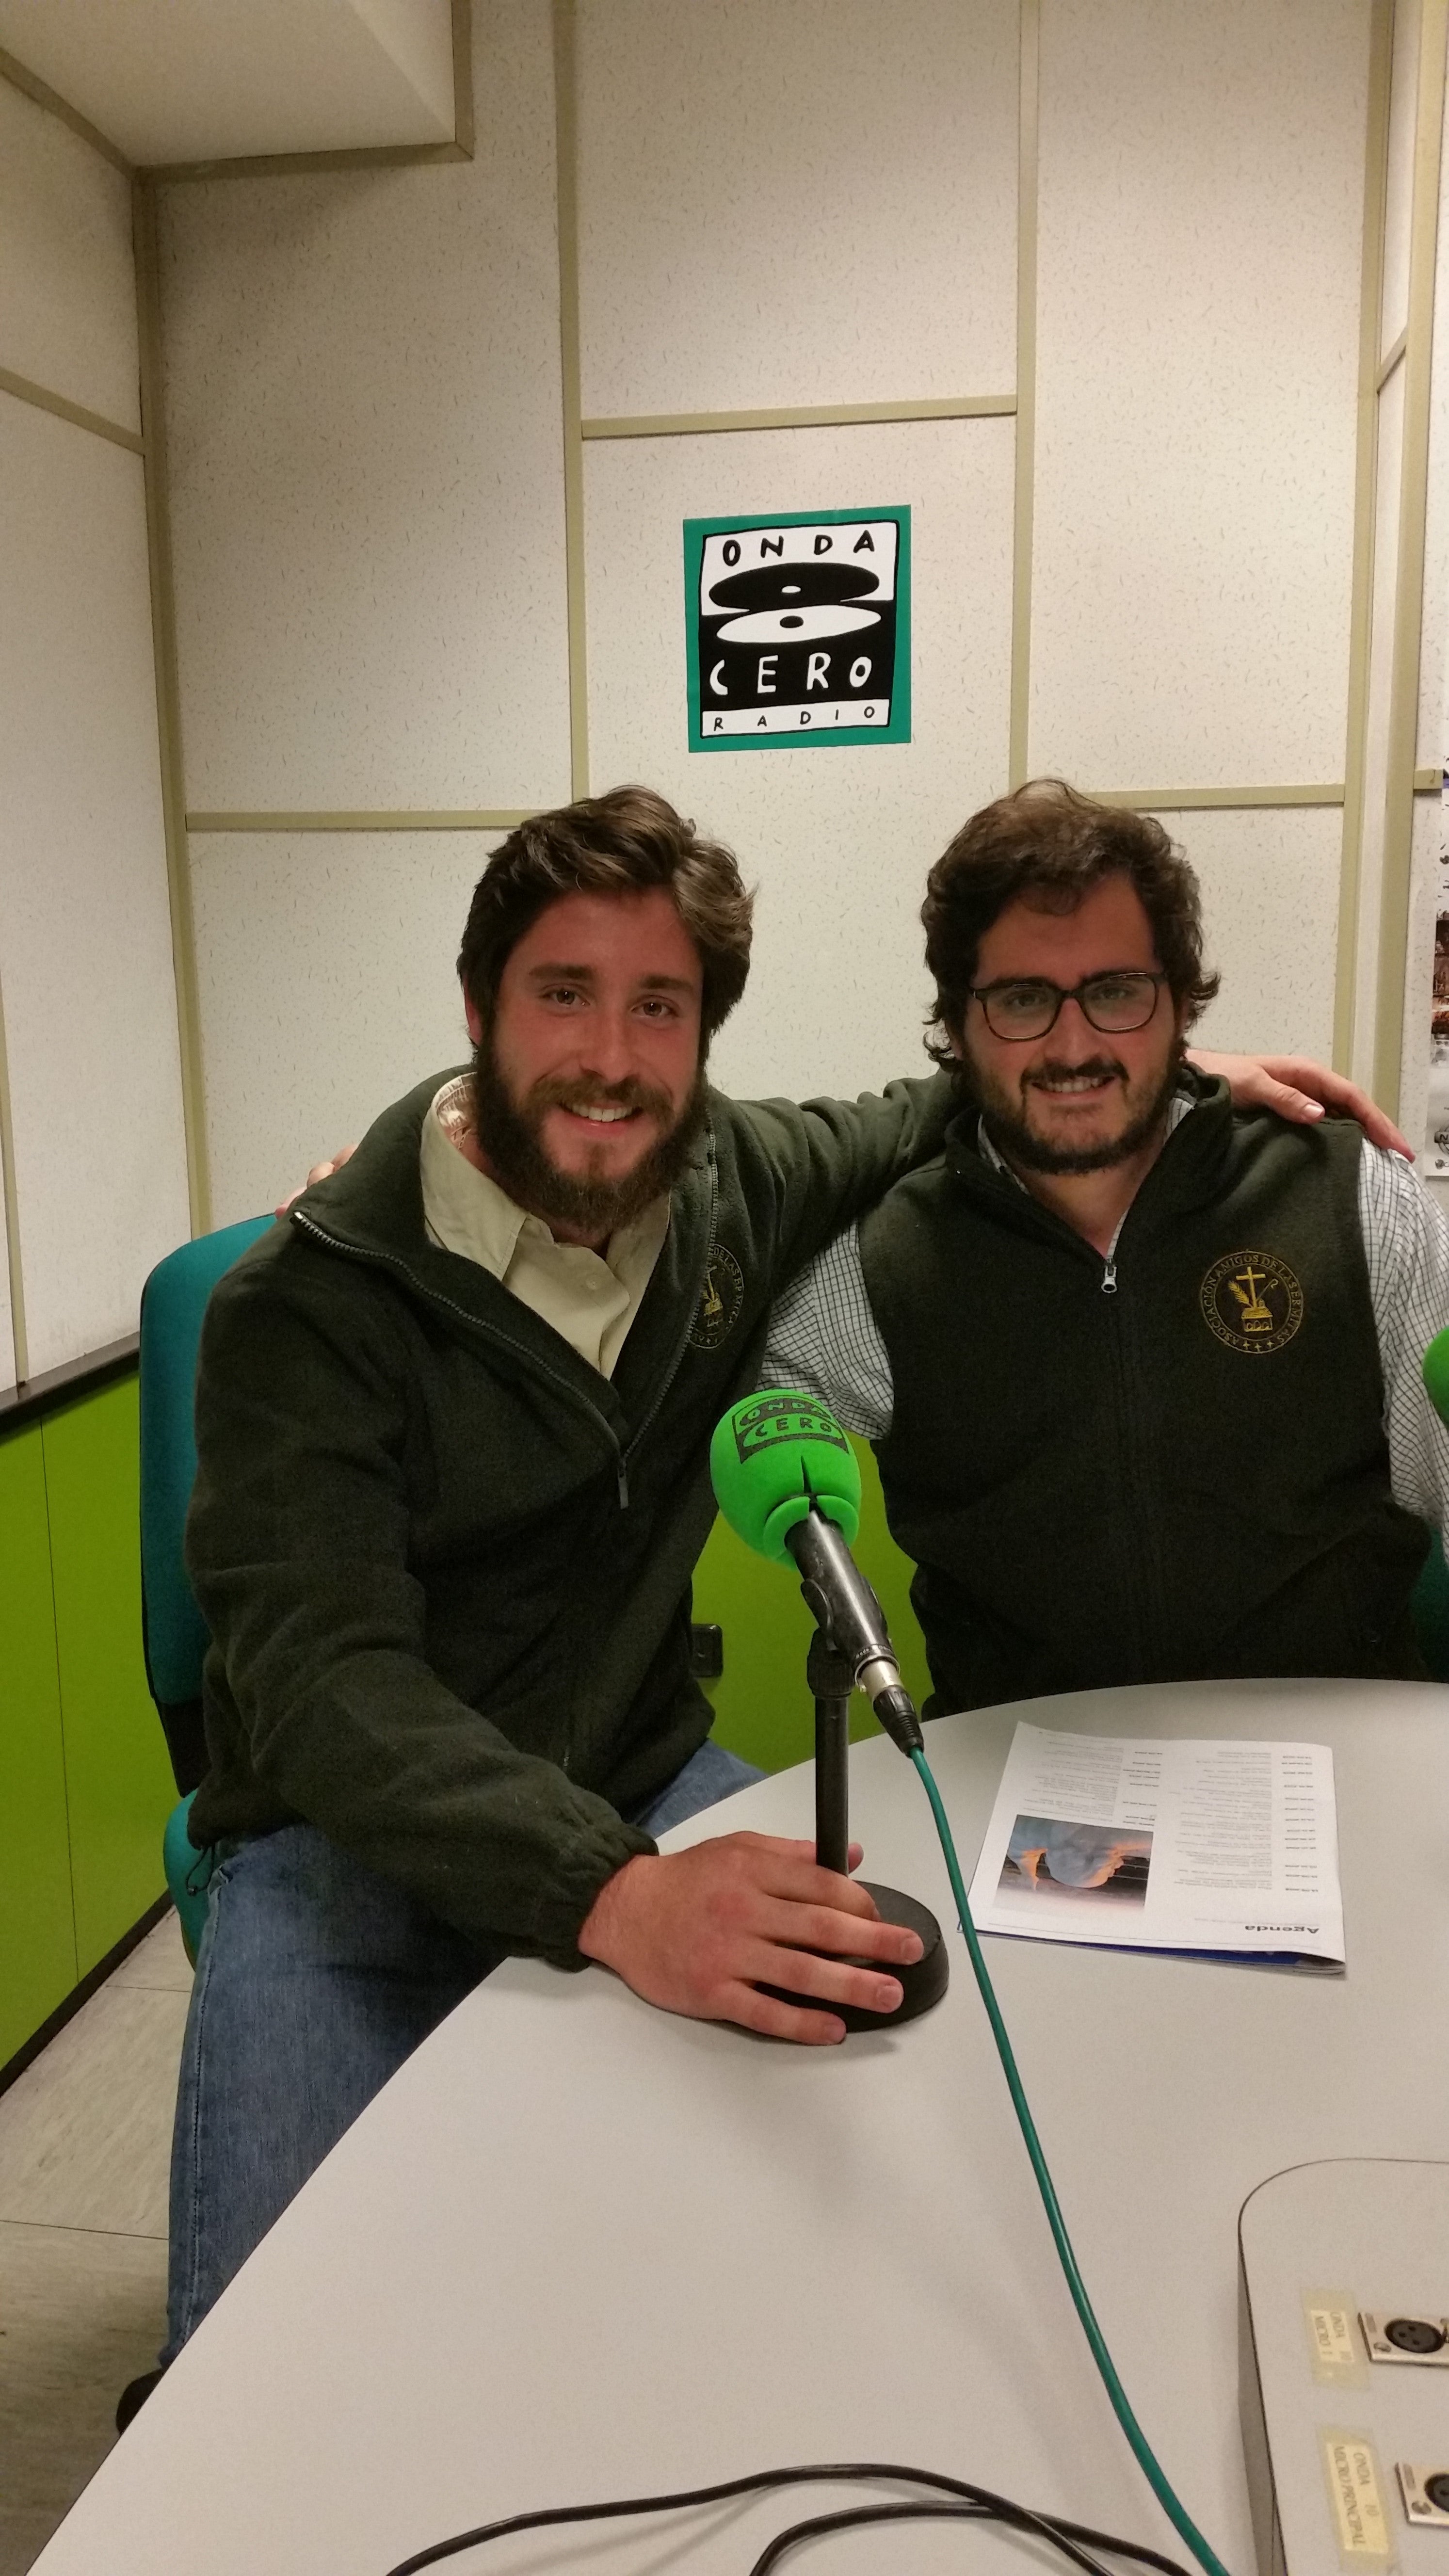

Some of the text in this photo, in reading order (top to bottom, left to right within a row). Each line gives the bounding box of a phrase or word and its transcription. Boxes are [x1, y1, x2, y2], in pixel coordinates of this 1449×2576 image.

[723, 530, 875, 566] ONDA
[709, 652, 872, 695] CERO
[713, 707, 875, 731] RADIO
[1215, 1254, 1259, 1277] AMIGOS
[1261, 1256, 1279, 1270] DE
[747, 1401, 831, 1420] ONDA
[755, 1417, 832, 1437] CERO
[1245, 1926, 1319, 1934] Agenda
[1315, 2316, 1331, 2346] MICRO
[1330, 2312, 1346, 2338] ONDA
[1353, 2452, 1370, 2485] ONDA
[1334, 2446, 1366, 2546] MICRO PRINCIPAL
